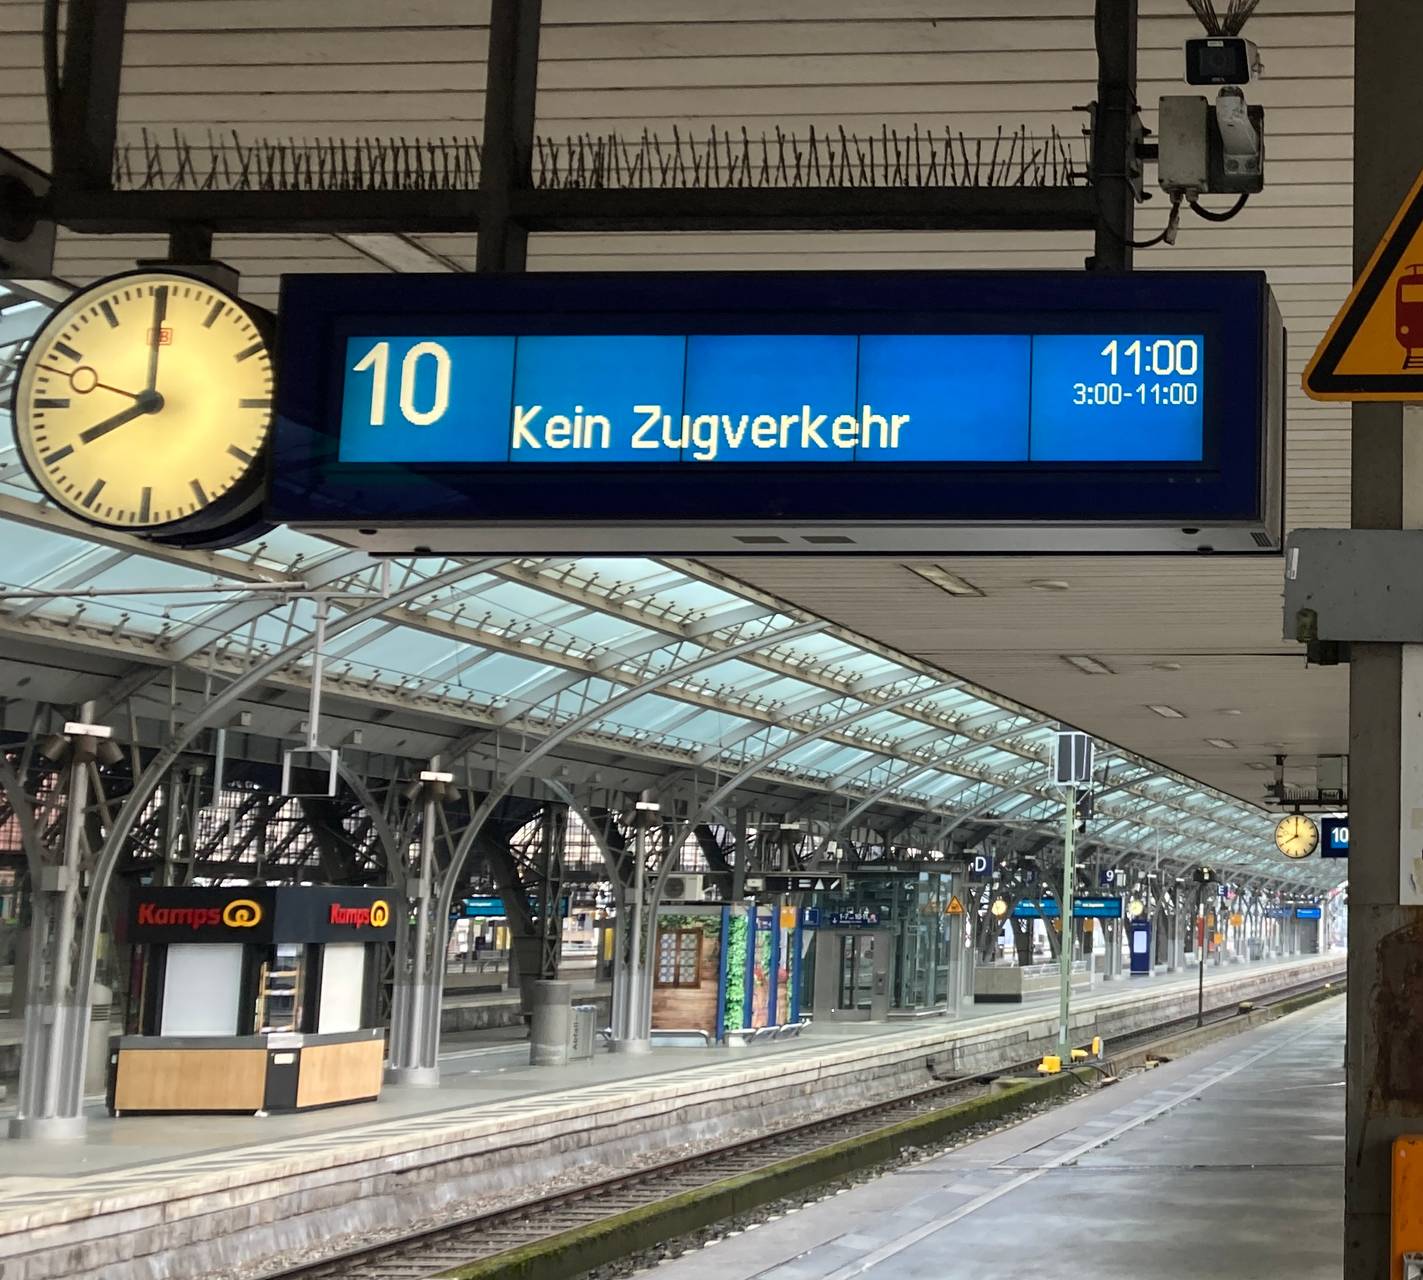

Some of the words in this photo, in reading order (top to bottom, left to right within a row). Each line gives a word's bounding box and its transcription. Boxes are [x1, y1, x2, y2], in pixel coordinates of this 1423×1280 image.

[1101, 339, 1198, 375] 11:00
[353, 341, 452, 426] 10
[1073, 382, 1197, 405] 3:00-11:00
[512, 405, 611, 449] Kein
[631, 404, 910, 461] Zugverkehr
[1331, 827, 1349, 843] 10
[974, 856, 987, 872] D
[1106, 869, 1115, 882] 9
[1218, 885, 1225, 895] E
[138, 903, 221, 929] Kamps
[330, 903, 370, 928] Kamps
